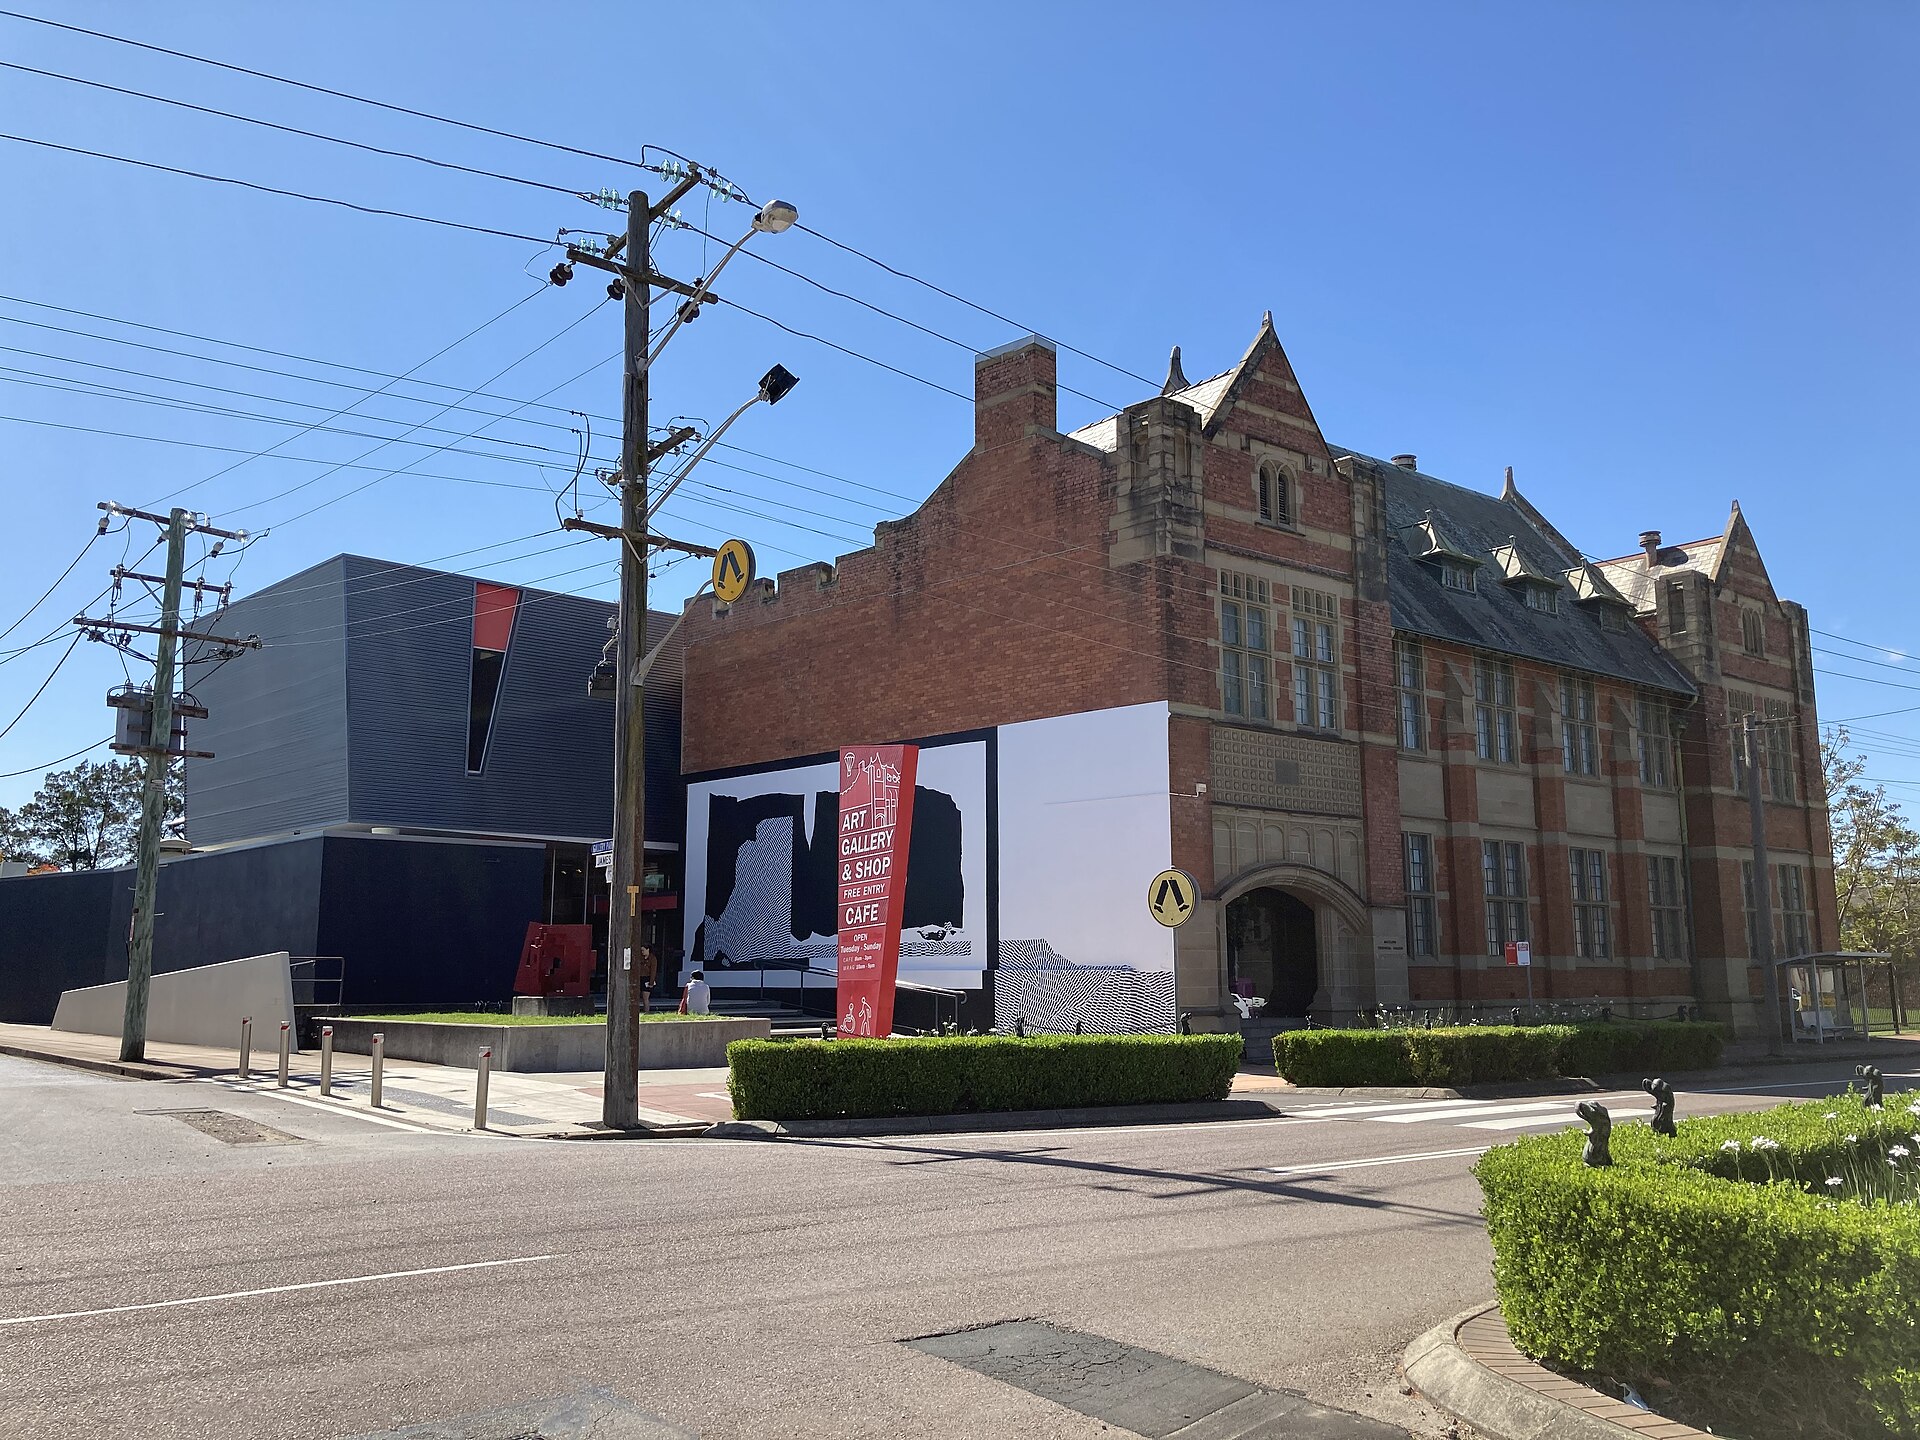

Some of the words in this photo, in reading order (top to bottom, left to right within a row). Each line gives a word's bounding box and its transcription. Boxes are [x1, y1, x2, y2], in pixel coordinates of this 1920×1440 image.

[842, 809, 867, 832] ART
[841, 829, 894, 856] GALLERY
[597, 855, 612, 866] JAMES
[841, 863, 852, 881] &
[855, 856, 891, 879] SHOP
[843, 886, 861, 900] FREE
[863, 883, 886, 896] ENTRY
[845, 903, 879, 925] CAFE
[853, 933, 868, 942] OPEN
[840, 944, 860, 954] Tuesday
[863, 942, 882, 951] Sunday
